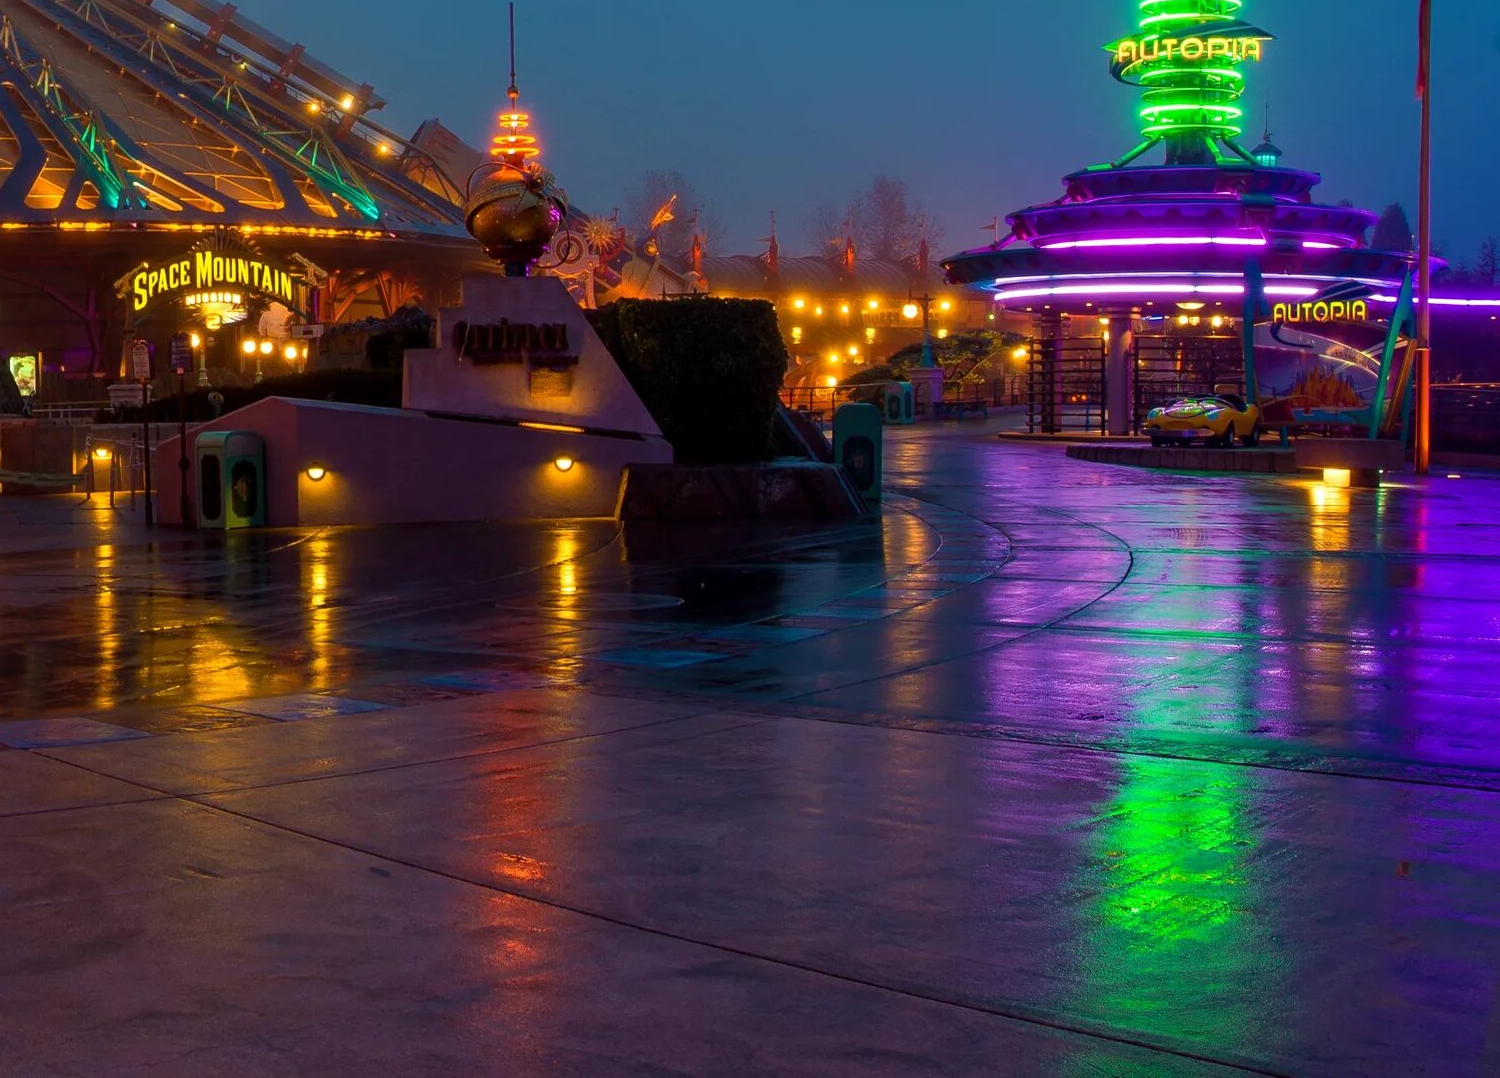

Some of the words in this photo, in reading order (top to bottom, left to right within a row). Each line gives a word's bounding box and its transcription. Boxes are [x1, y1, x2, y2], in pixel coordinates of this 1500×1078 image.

[1118, 37, 1261, 63] AUTOPIA
[134, 260, 191, 310] SPACE
[195, 251, 292, 301] MOUNTAIN
[1273, 300, 1366, 323] AUTOPIA
